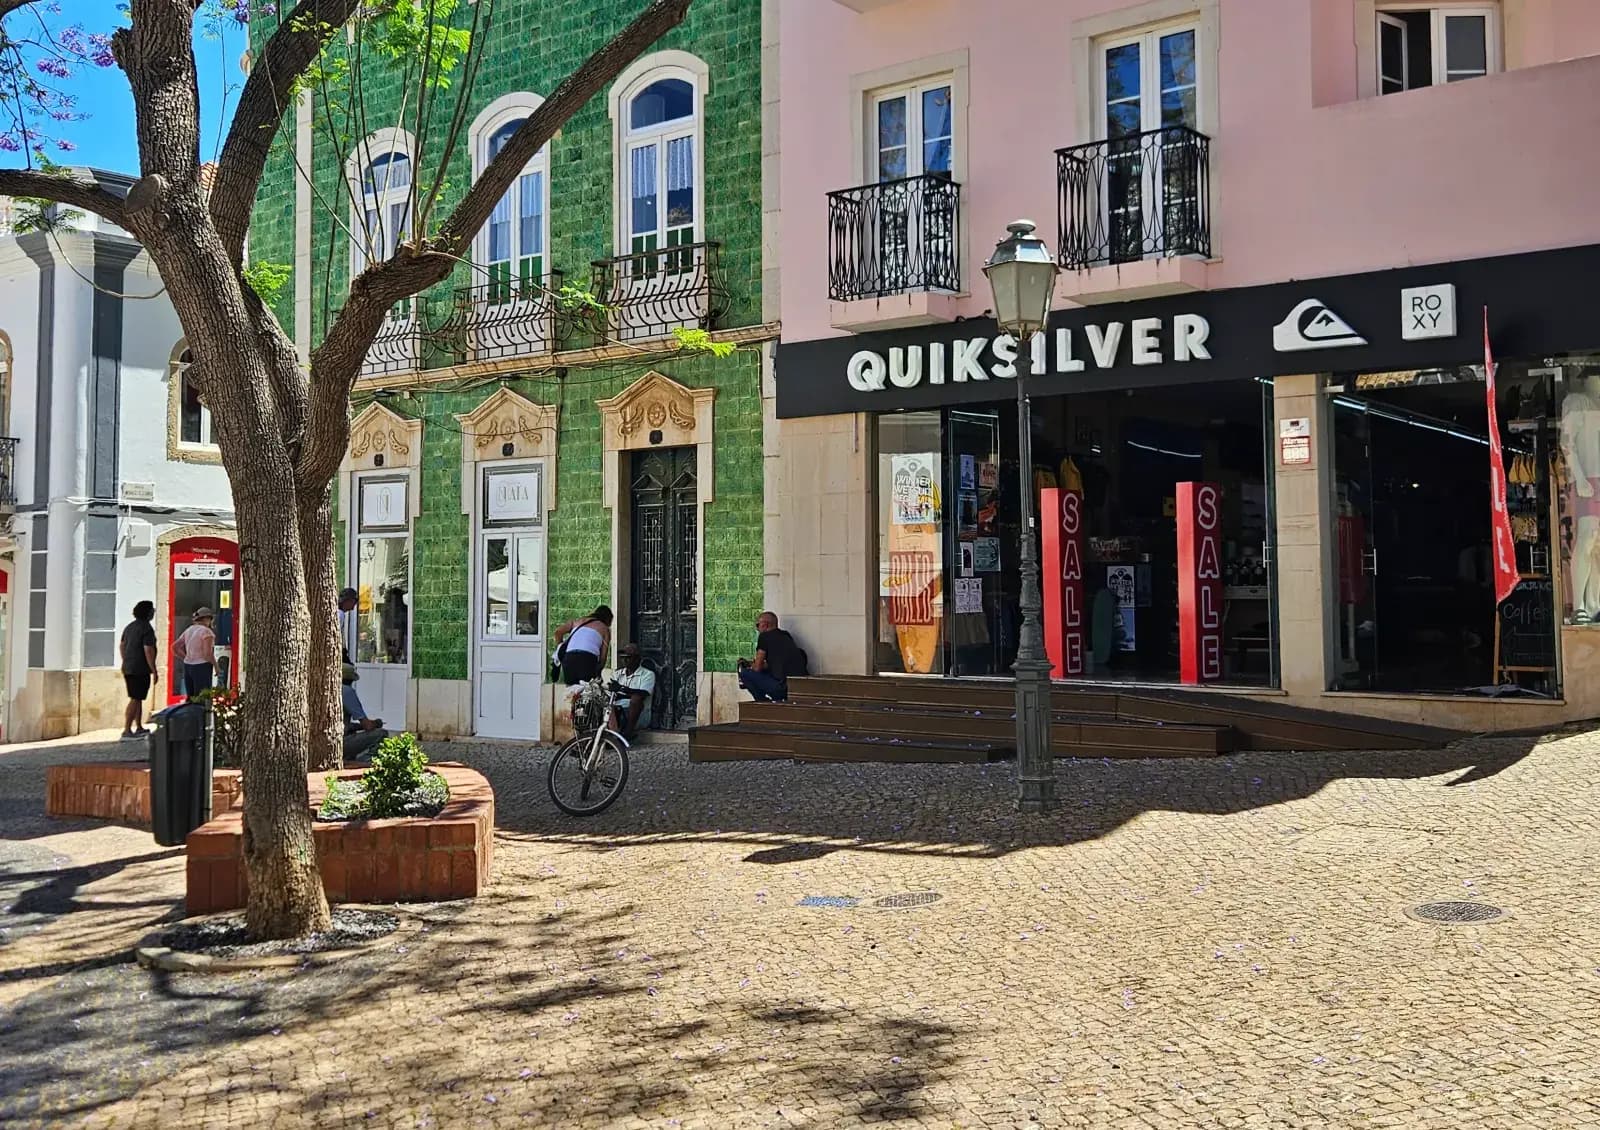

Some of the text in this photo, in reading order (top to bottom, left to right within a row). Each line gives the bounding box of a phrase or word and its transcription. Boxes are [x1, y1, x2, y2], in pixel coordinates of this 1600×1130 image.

[1411, 294, 1442, 312] RO
[1411, 311, 1442, 330] XY
[846, 313, 1213, 393] QUIKSILVER
[1062, 493, 1082, 674] SALE
[1198, 486, 1220, 679] SALE
